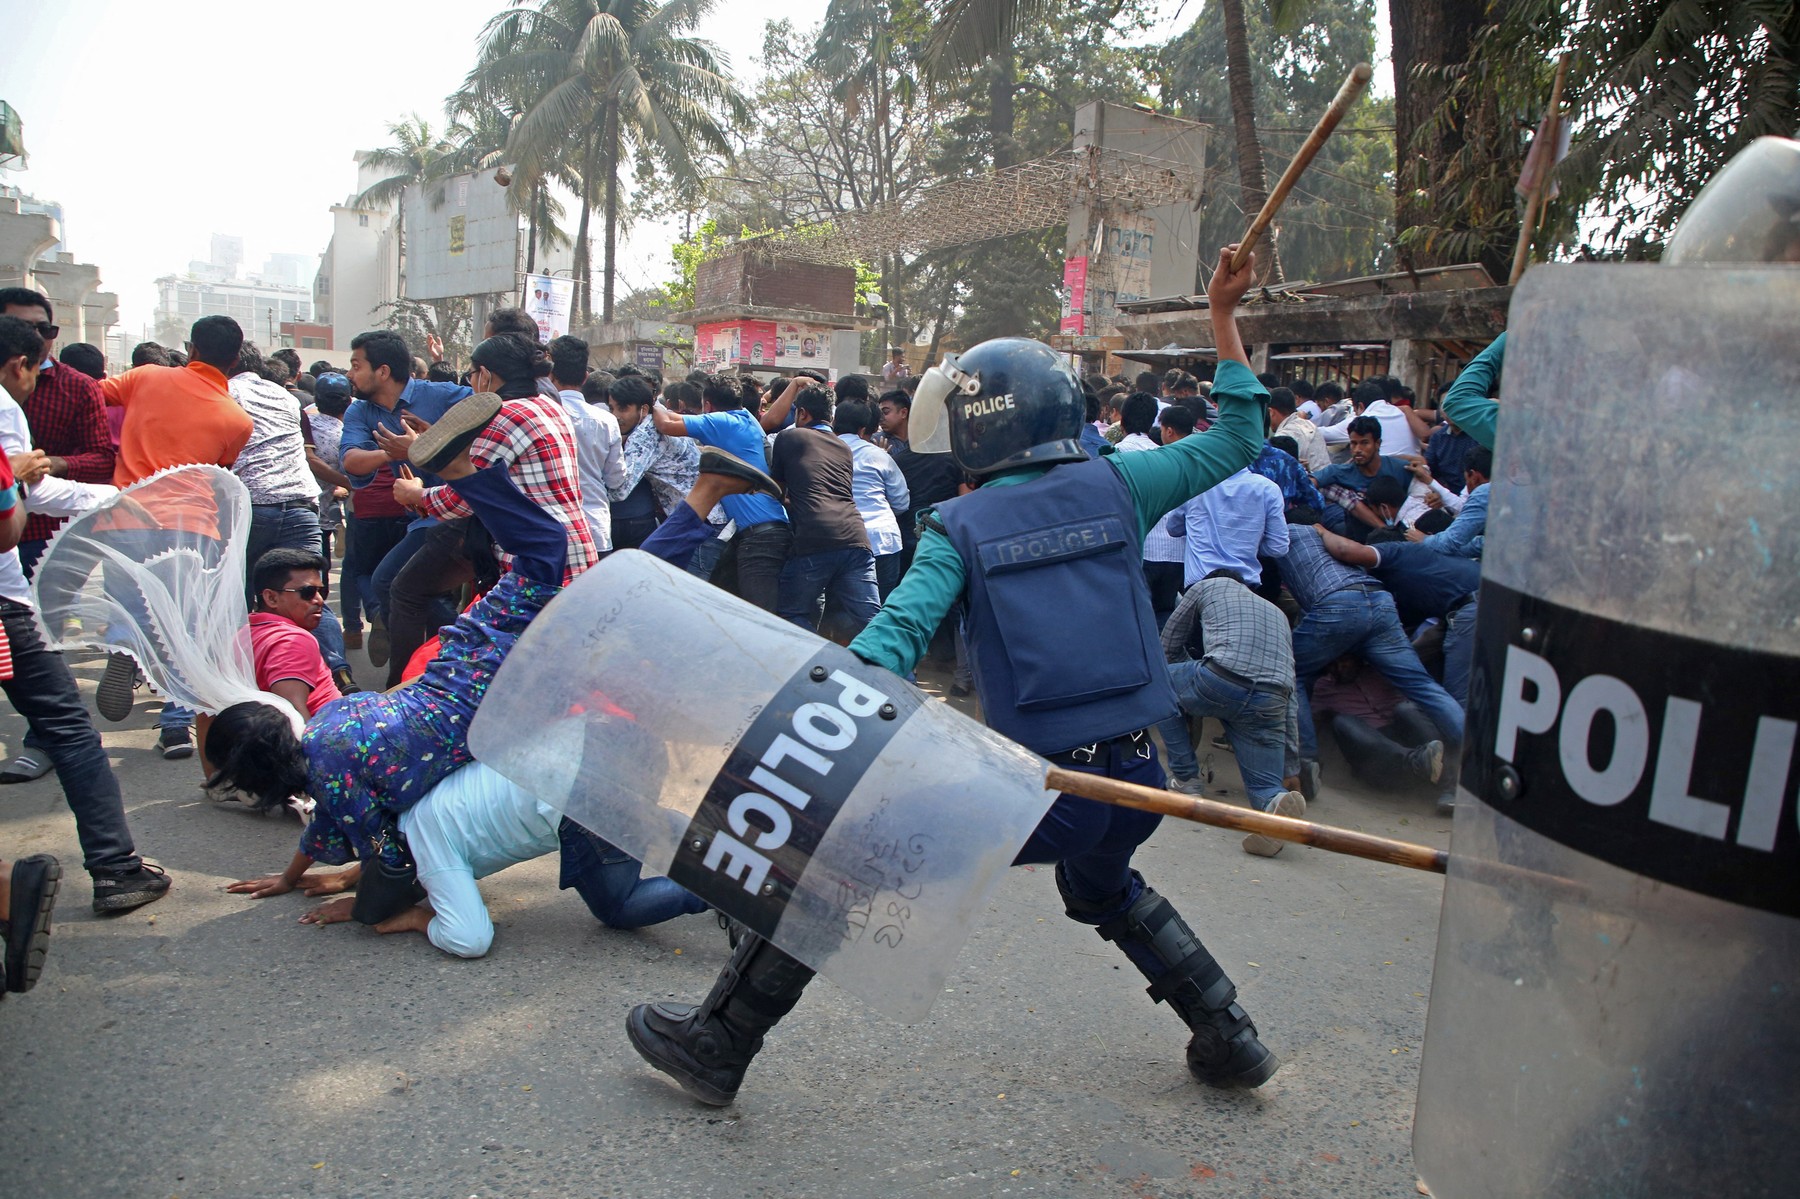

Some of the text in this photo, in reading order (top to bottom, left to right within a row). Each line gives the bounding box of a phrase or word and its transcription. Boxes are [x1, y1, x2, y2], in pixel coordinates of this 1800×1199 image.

[964, 393, 1015, 419] POLICE
[1009, 529, 1097, 562] POLICE
[703, 669, 889, 896] POLICE
[1495, 644, 1800, 851] POLI
